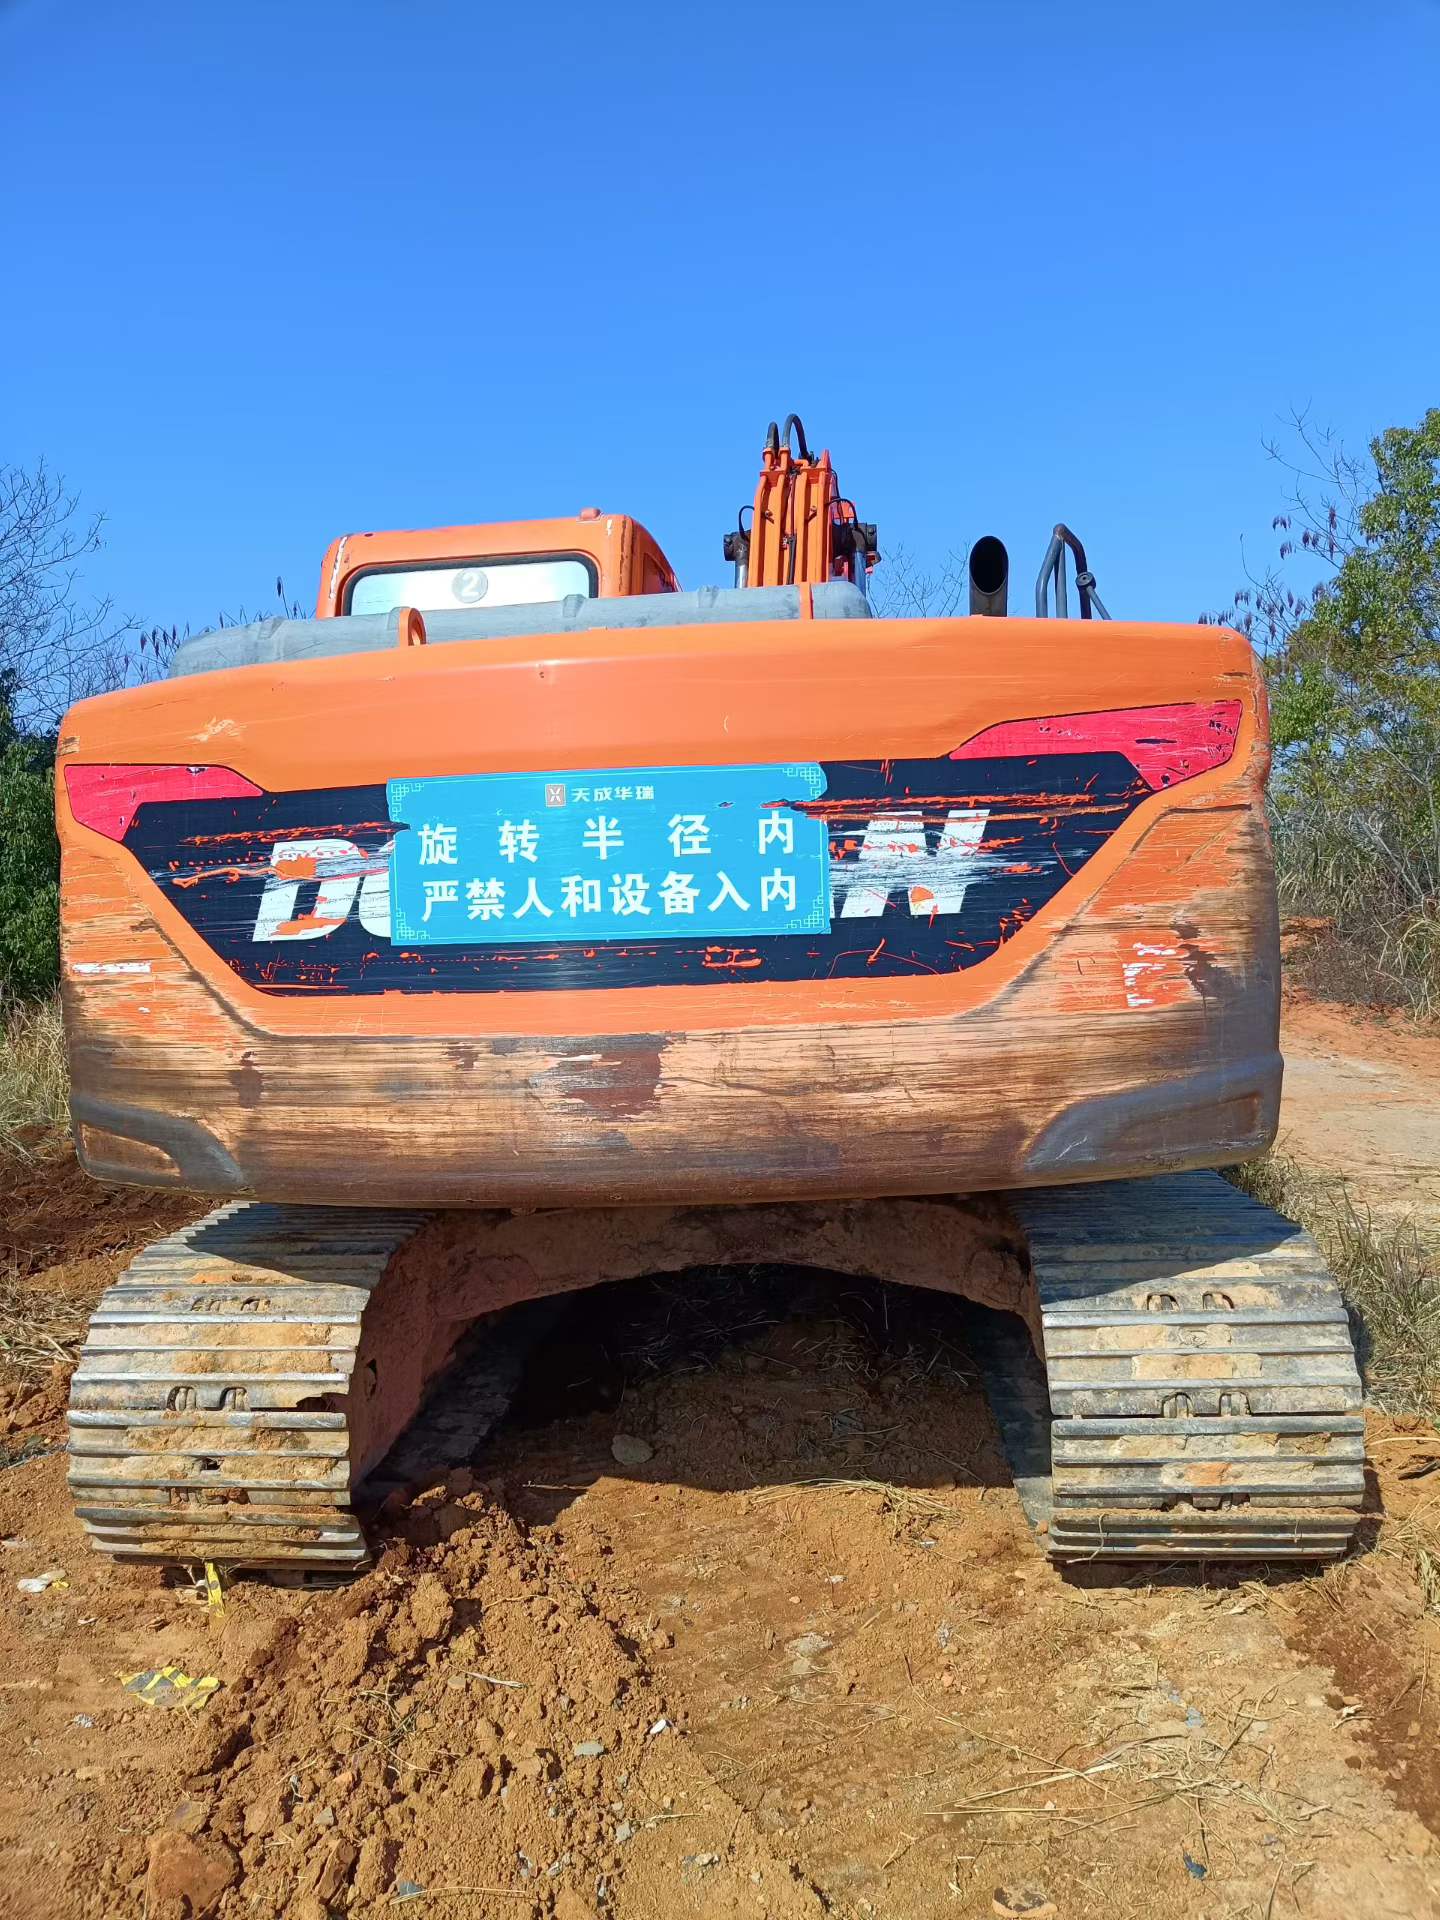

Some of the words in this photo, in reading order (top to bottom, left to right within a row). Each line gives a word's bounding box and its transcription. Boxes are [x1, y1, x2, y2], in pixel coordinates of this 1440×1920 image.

[571, 785, 655, 802] 天成华瑞
[421, 867, 797, 923] 严禁人和设备入内
